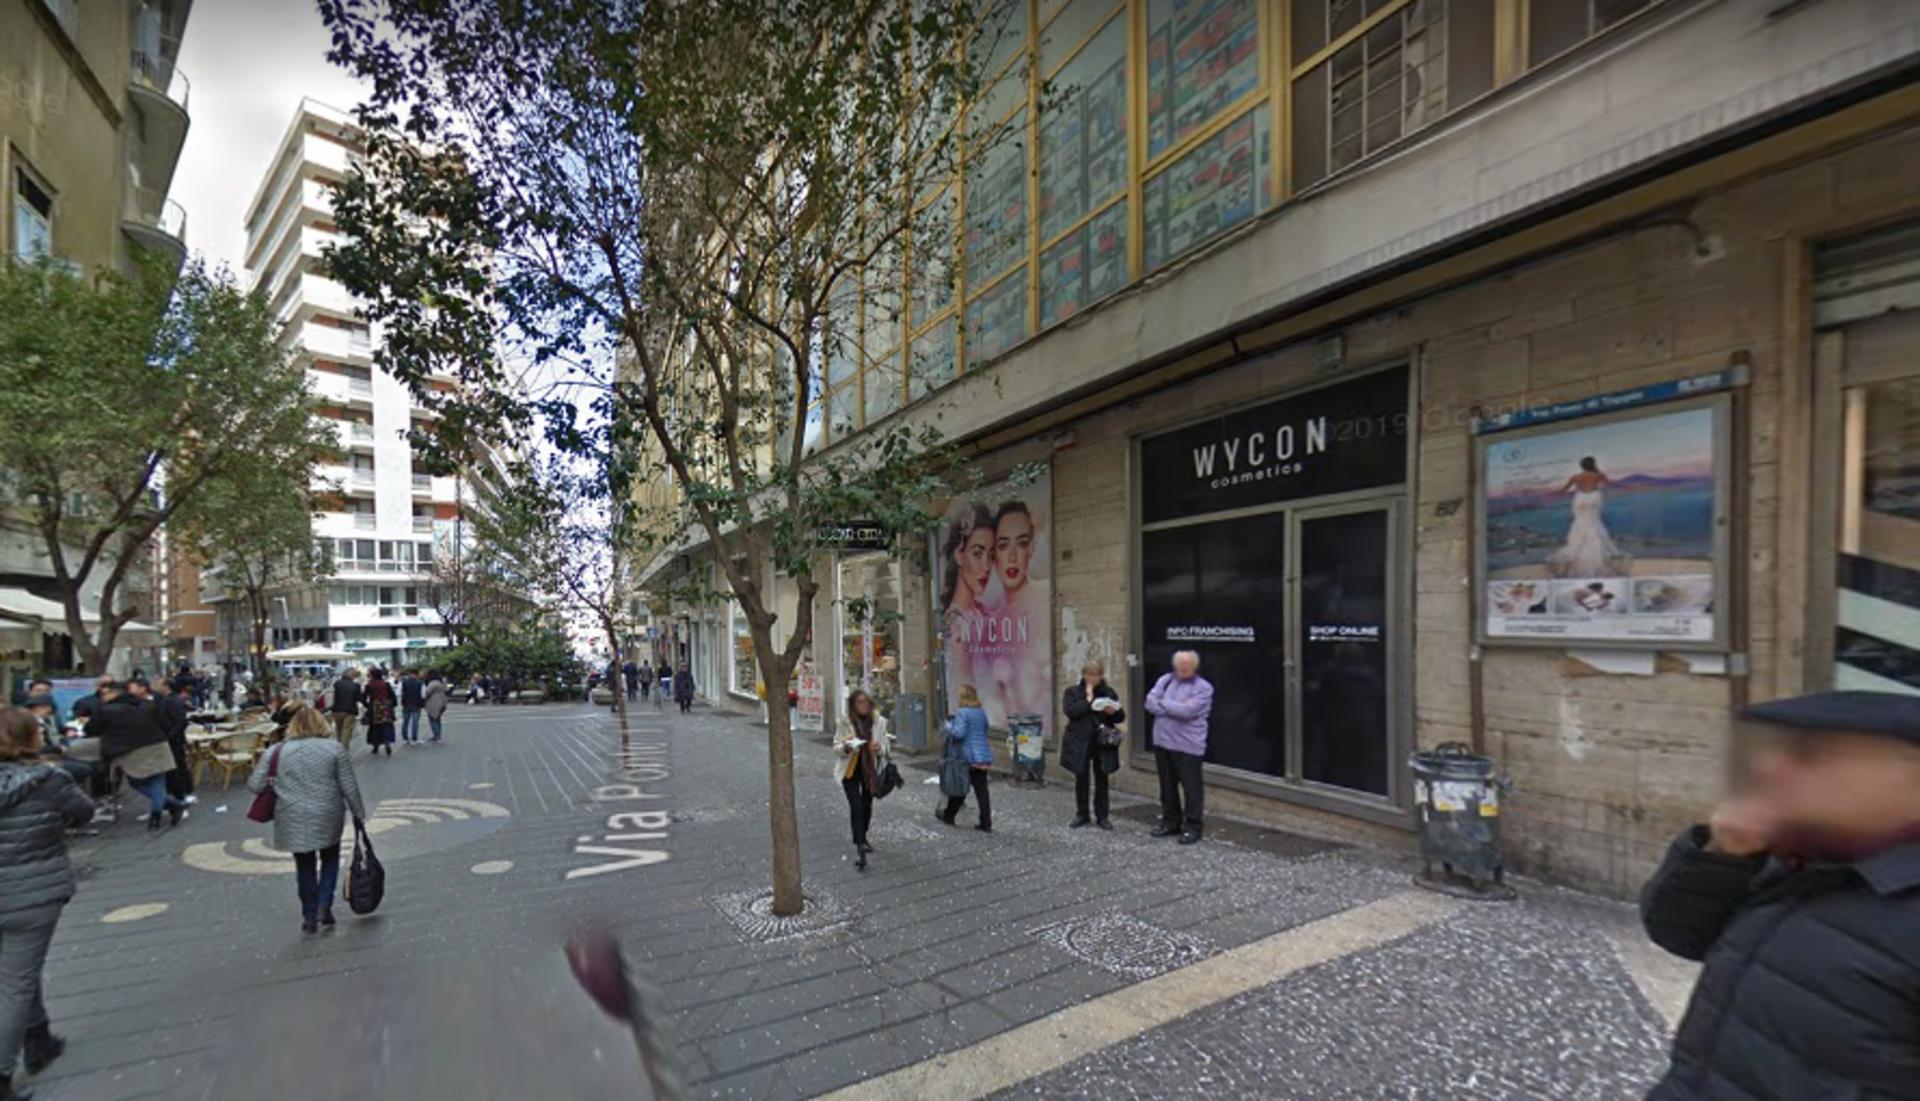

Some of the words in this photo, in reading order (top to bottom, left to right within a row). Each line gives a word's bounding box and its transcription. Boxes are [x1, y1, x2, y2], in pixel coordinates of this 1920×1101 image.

[1193, 416, 1326, 478] WYCON
[1211, 462, 1302, 489] cosmetics
[958, 616, 1027, 642] WYCON
[1189, 627, 1254, 637] FRANCHISING
[1310, 626, 1337, 636] SHOP
[1338, 626, 1379, 636] ONLINE
